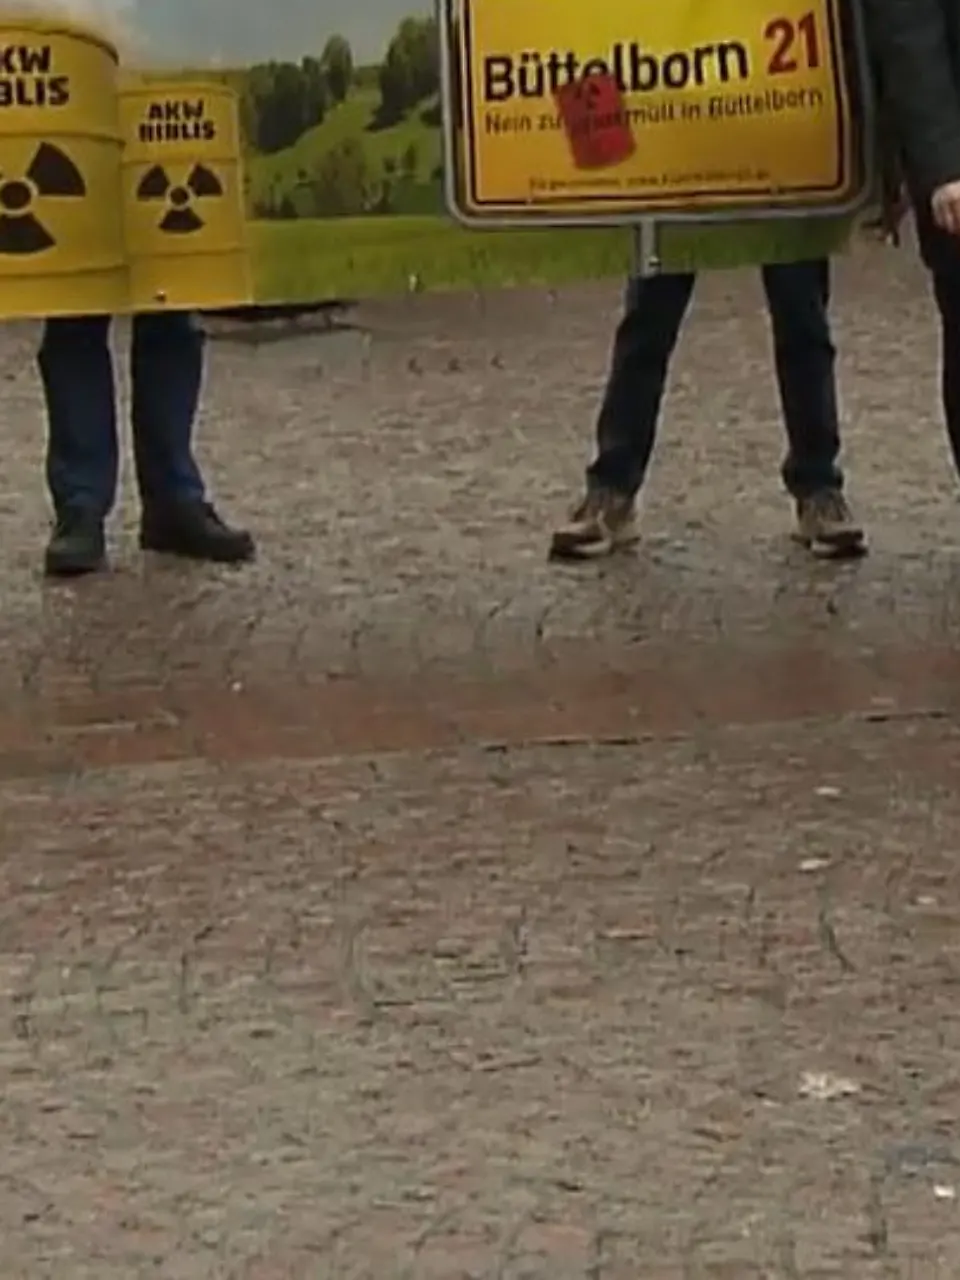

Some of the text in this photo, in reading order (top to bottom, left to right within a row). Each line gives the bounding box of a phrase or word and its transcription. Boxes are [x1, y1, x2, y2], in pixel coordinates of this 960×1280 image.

[764, 11, 821, 74] 21
[148, 99, 205, 121] AKW
[485, 110, 532, 135] Nein
